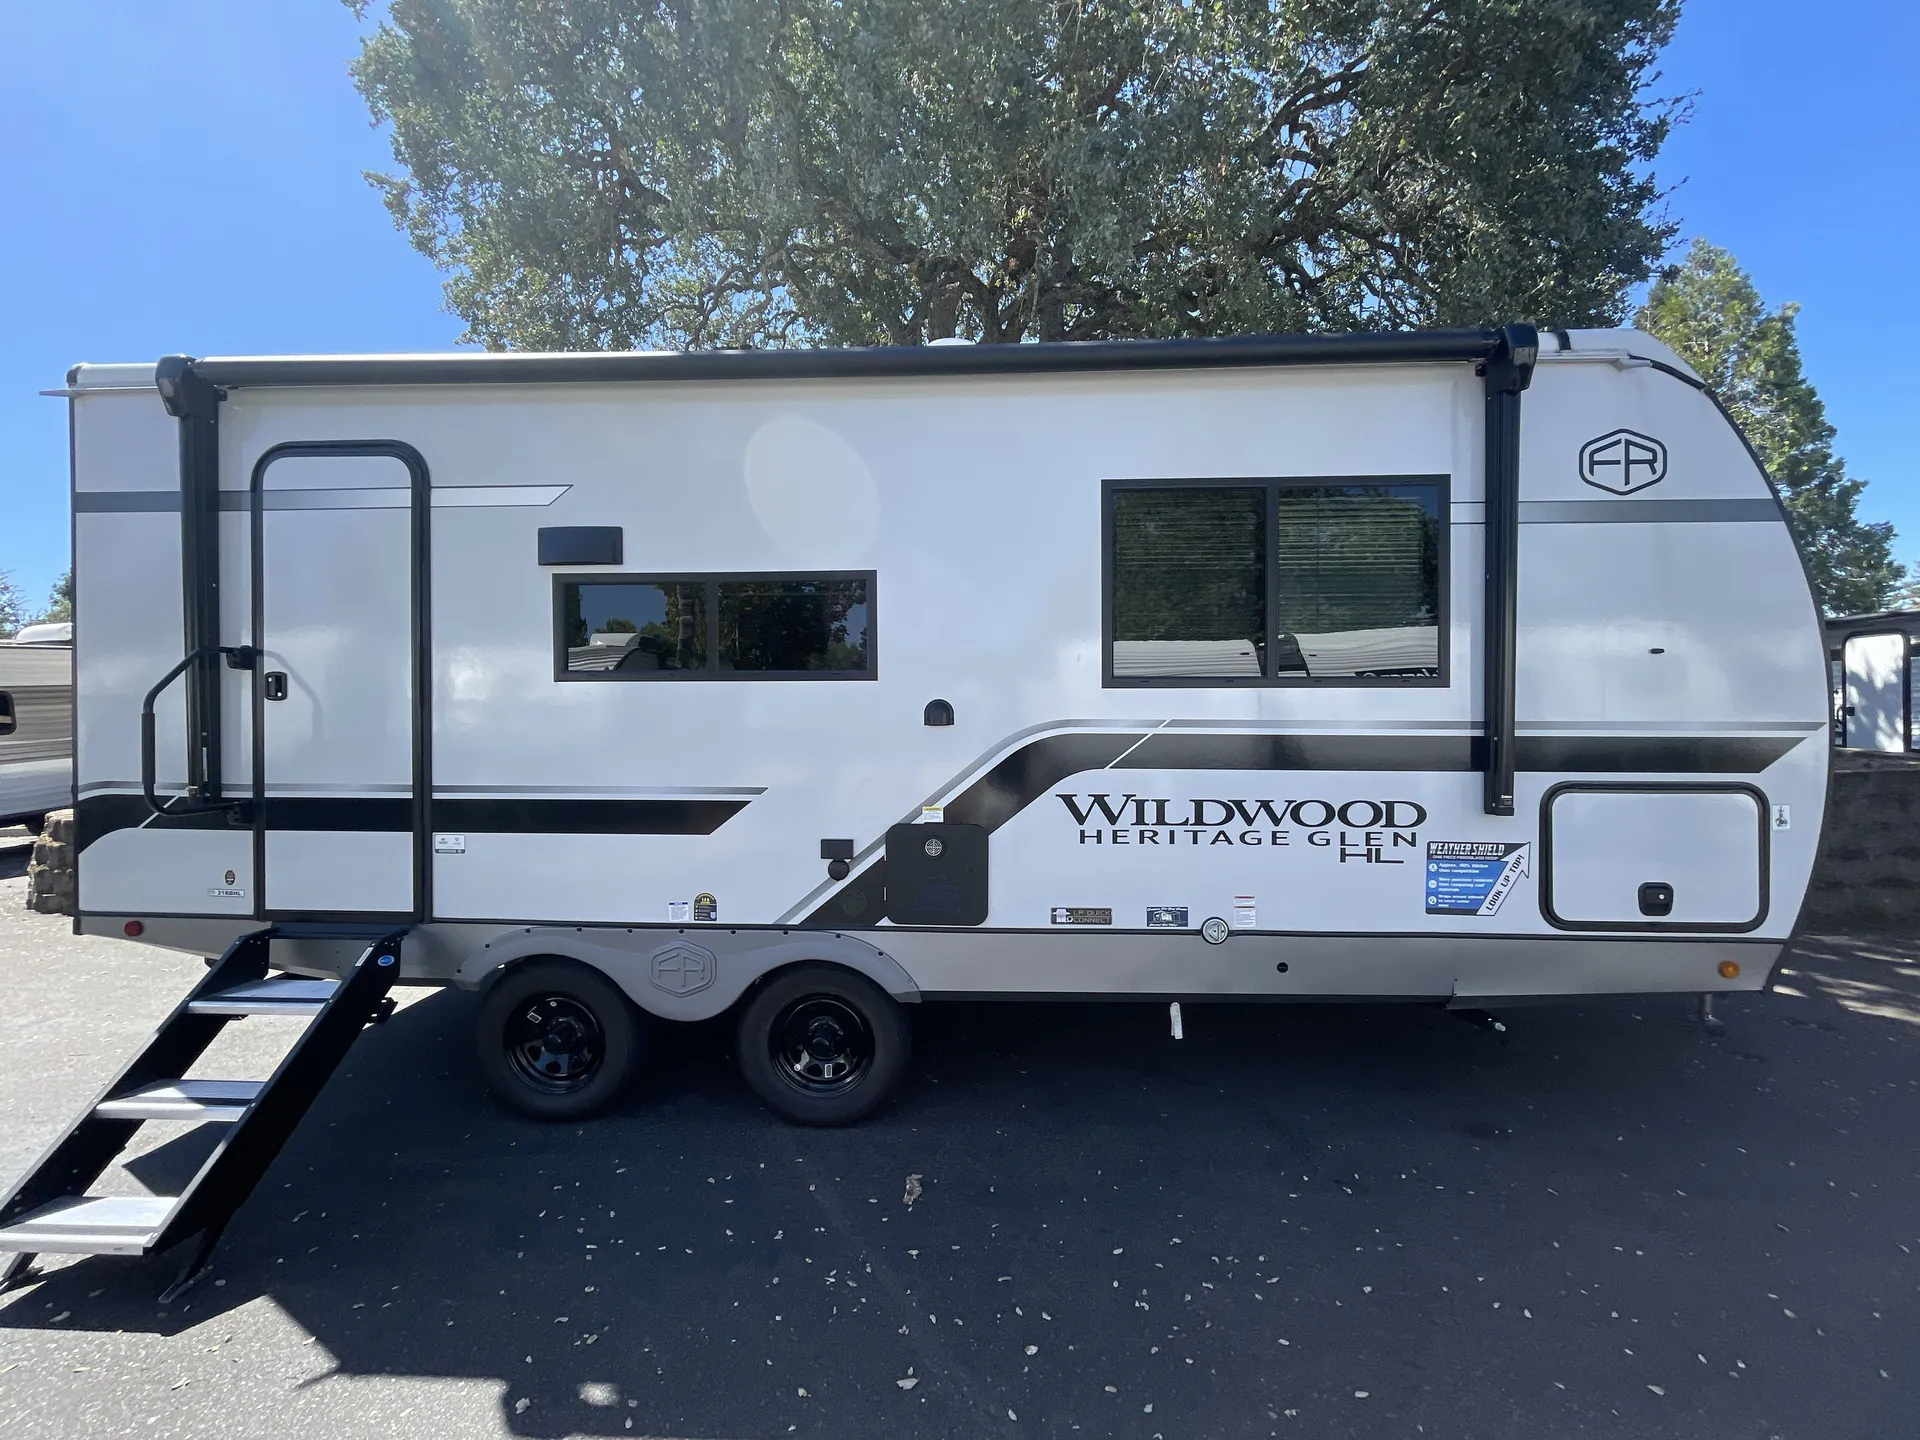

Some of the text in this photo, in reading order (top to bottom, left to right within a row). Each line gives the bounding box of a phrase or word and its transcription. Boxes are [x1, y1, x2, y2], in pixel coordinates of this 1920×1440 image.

[1055, 793, 1428, 829] WILDWOOD
[1078, 829, 1417, 848] HERITAGE GLEN
[1339, 847, 1405, 864] HL
[1485, 854, 1525, 911] LOOK UP TOP!
